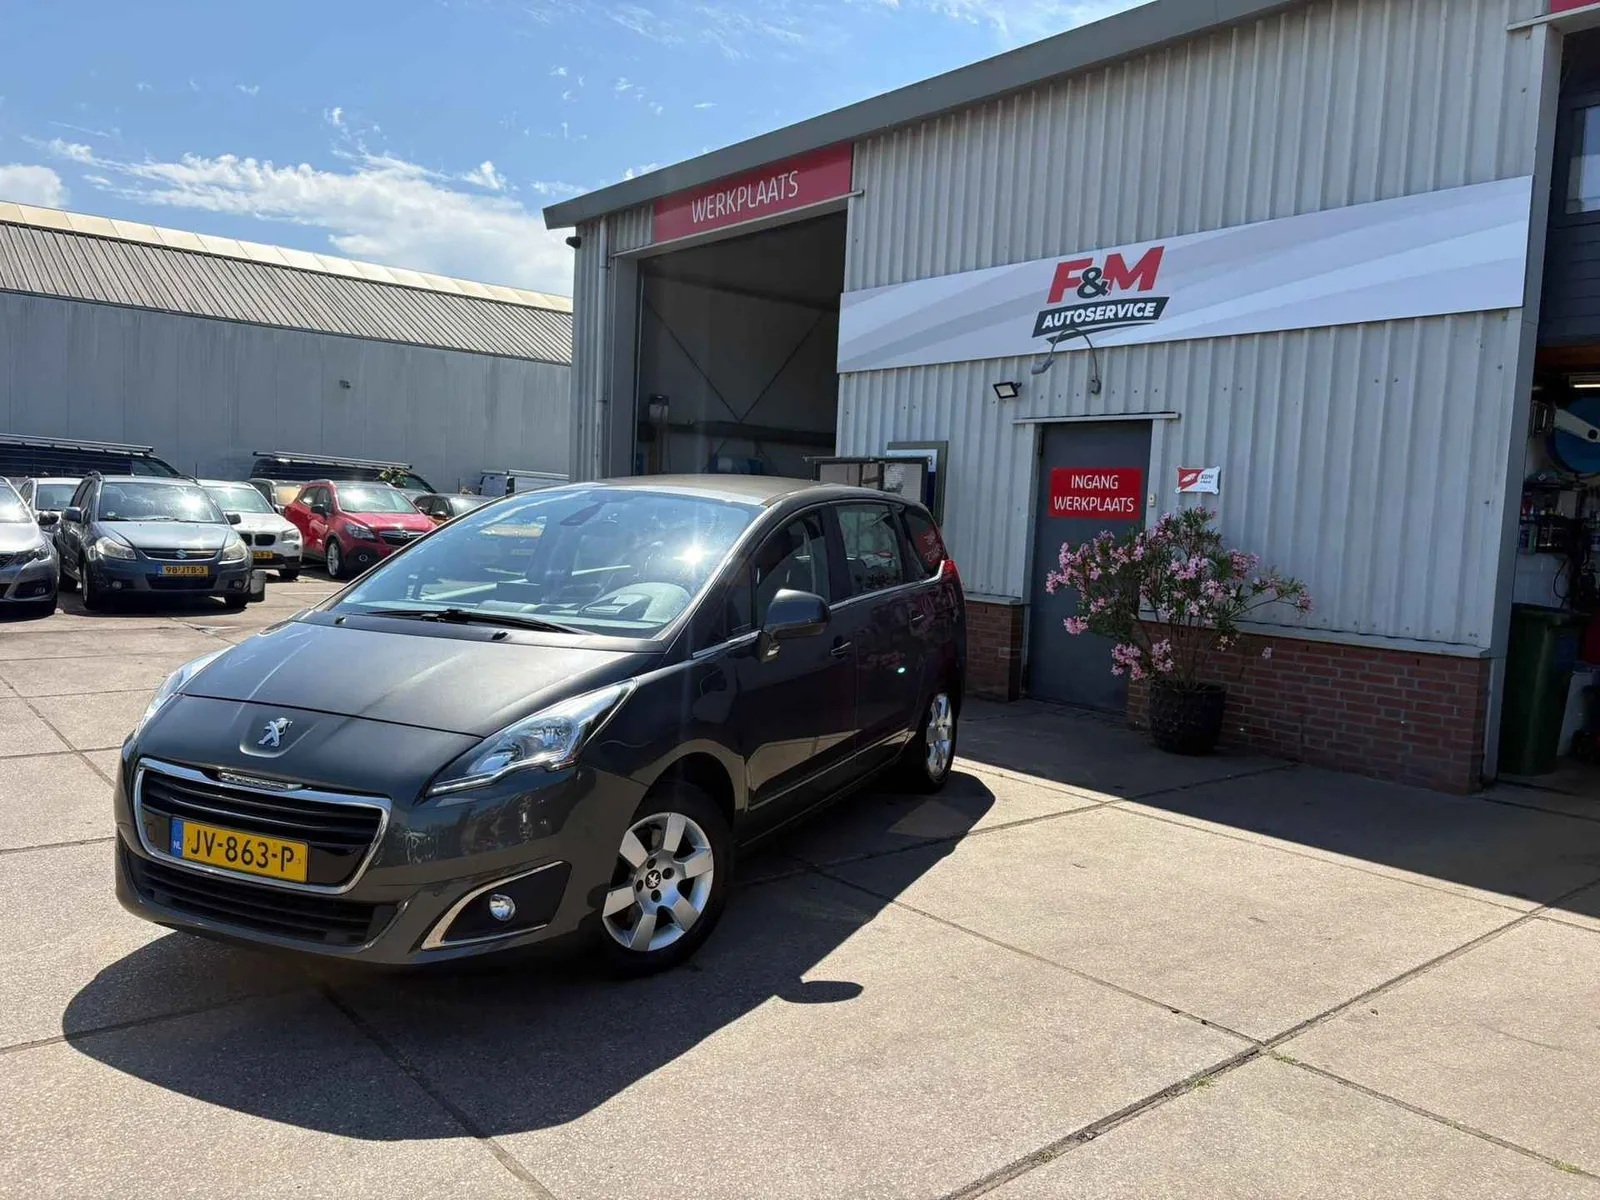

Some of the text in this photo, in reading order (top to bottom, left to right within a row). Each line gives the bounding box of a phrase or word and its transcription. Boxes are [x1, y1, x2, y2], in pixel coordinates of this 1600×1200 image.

[692, 170, 799, 224] WERKPLAATS
[1047, 246, 1165, 304] F&M
[1041, 302, 1157, 329] AUTOSERVICE
[1071, 474, 1120, 490] INGANG
[1053, 496, 1135, 513] WERKPLAATS
[190, 829, 295, 872] JV-863-P
